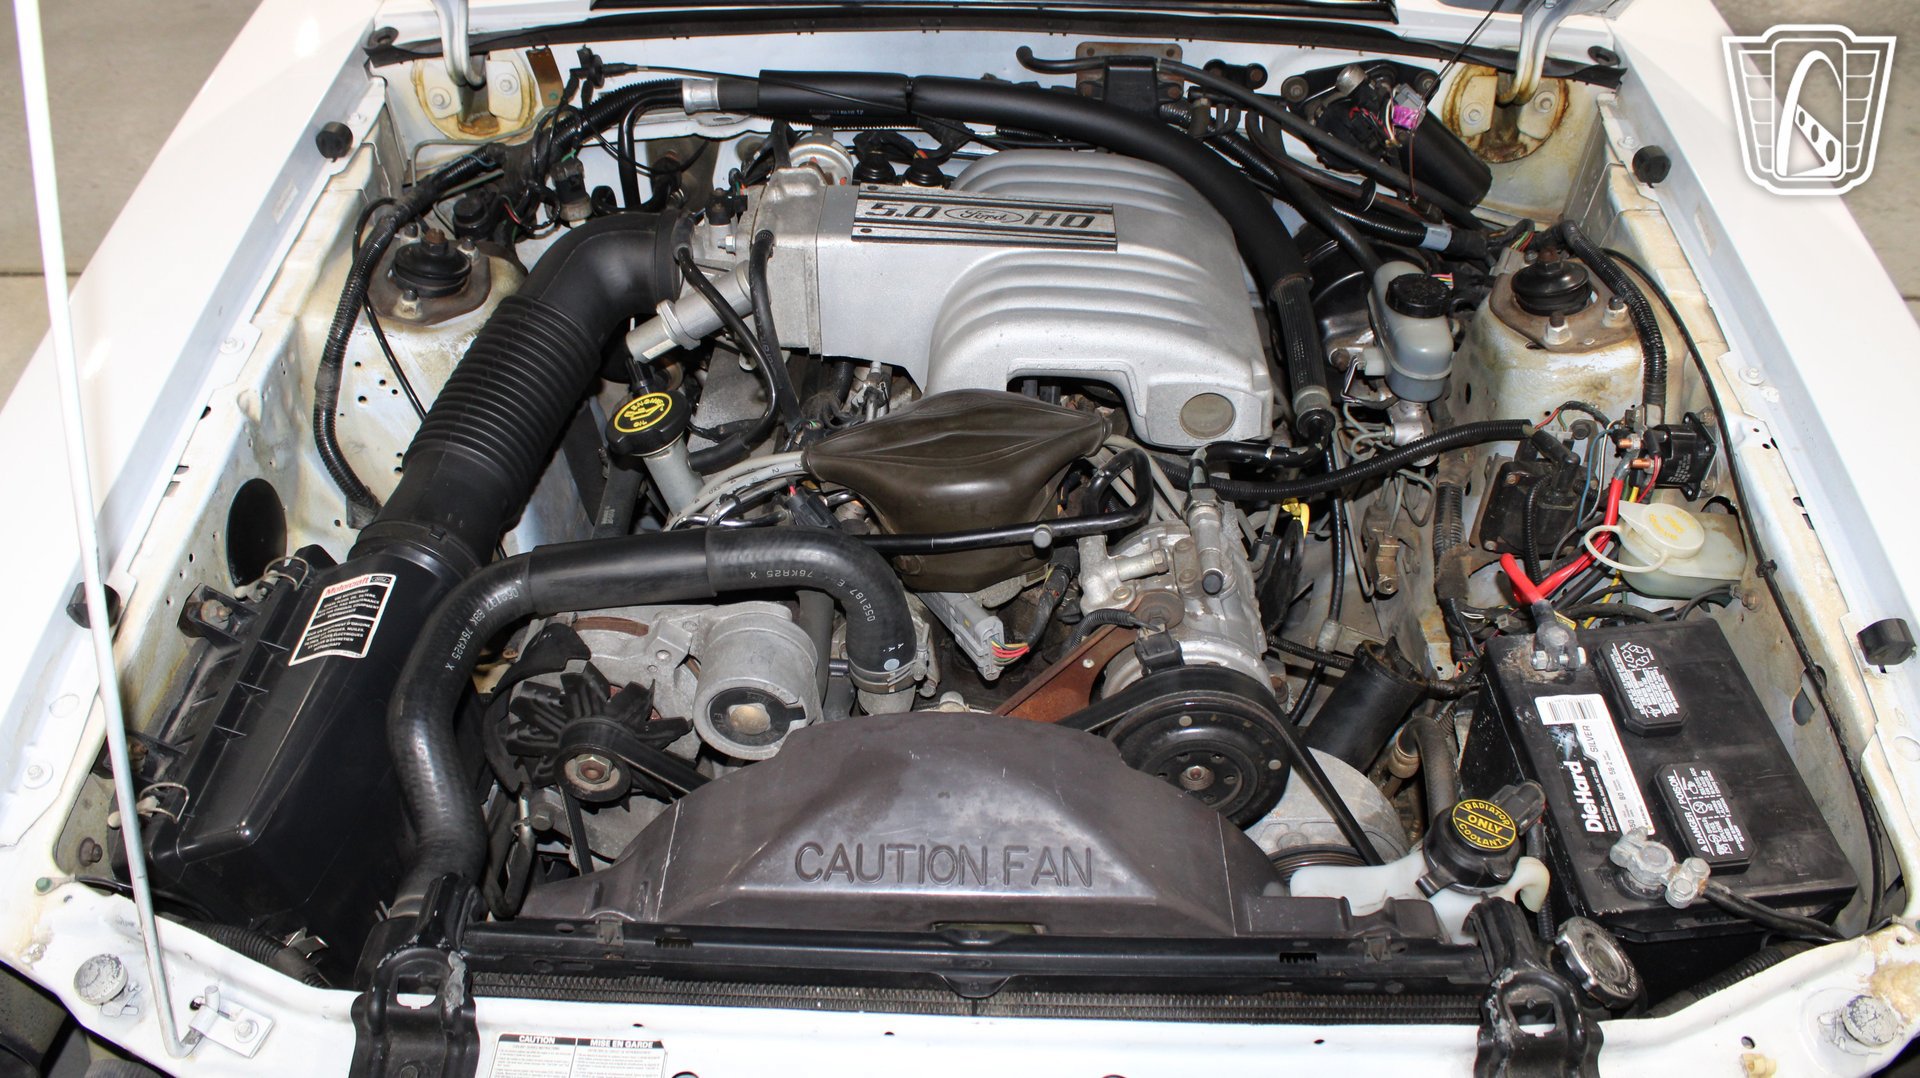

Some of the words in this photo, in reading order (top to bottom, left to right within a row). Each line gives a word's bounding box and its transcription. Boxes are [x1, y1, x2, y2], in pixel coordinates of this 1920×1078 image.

[865, 202, 941, 219] 5.0
[1024, 211, 1095, 229] HO
[633, 420, 648, 428] OIL
[1563, 760, 1606, 833] DieHard
[1667, 775, 1687, 805] POISON
[1464, 802, 1511, 826] RADIATOR
[1467, 814, 1503, 834] ONLY
[1459, 823, 1503, 847] COOLANT
[1684, 811, 1706, 845] DANGER
[794, 841, 988, 886] CAUTION
[1003, 845, 1093, 888] FAN
[519, 1035, 556, 1045] CAUTION
[590, 1038, 610, 1048] MISE
[611, 1040, 623, 1048] EN
[625, 1041, 654, 1049] GARDE
